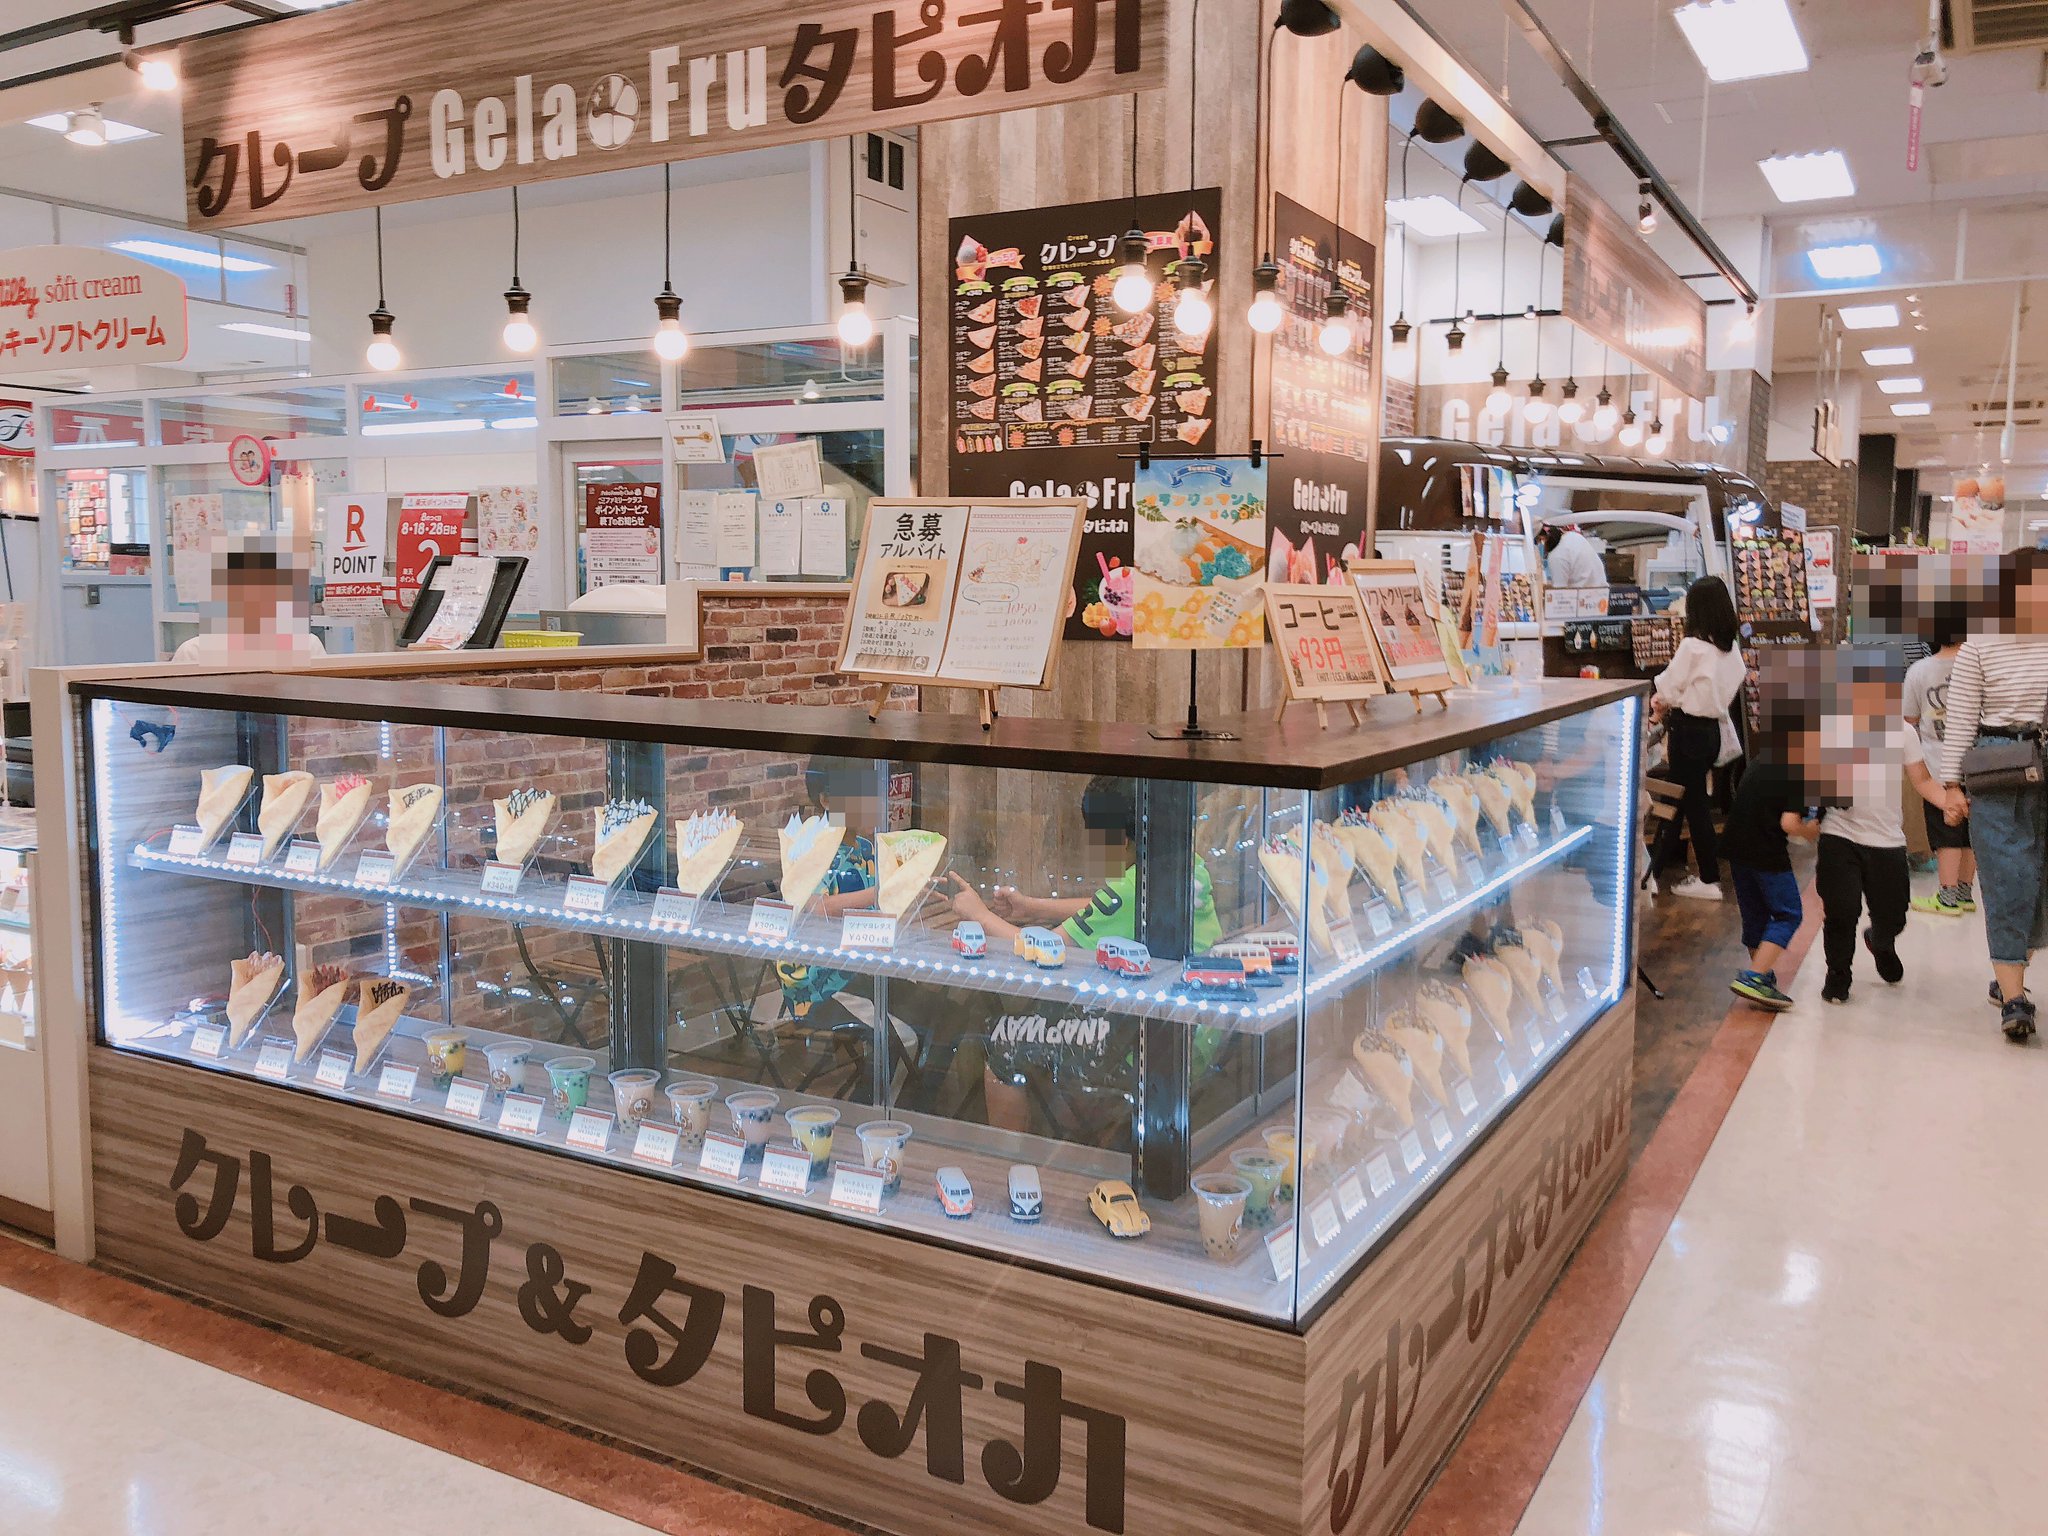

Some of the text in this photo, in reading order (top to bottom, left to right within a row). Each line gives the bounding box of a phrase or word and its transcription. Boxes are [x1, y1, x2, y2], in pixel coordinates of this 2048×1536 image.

[193, 0, 1142, 218] クレープ Gela Fru タピオカ
[1039, 234, 1117, 264] クレープ
[45, 275, 78, 304] soft
[83, 275, 142, 300] cream
[0, 315, 166, 358] キーソフトクリーム
[1440, 390, 1720, 448] Gela Fru
[594, 504, 649, 515] ポイントサービス
[599, 515, 645, 526] 終了のお知らせ
[893, 512, 943, 542] 急募
[1083, 519, 1129, 534] タピオカ
[333, 556, 377, 575] POINT
[880, 542, 947, 560] アルバイト
[335, 584, 382, 596] 楽天ポイントカード
[1362, 587, 1423, 607] ソフトクリーム
[1279, 600, 1358, 630] コーヒー
[1299, 636, 1347, 671] 93円
